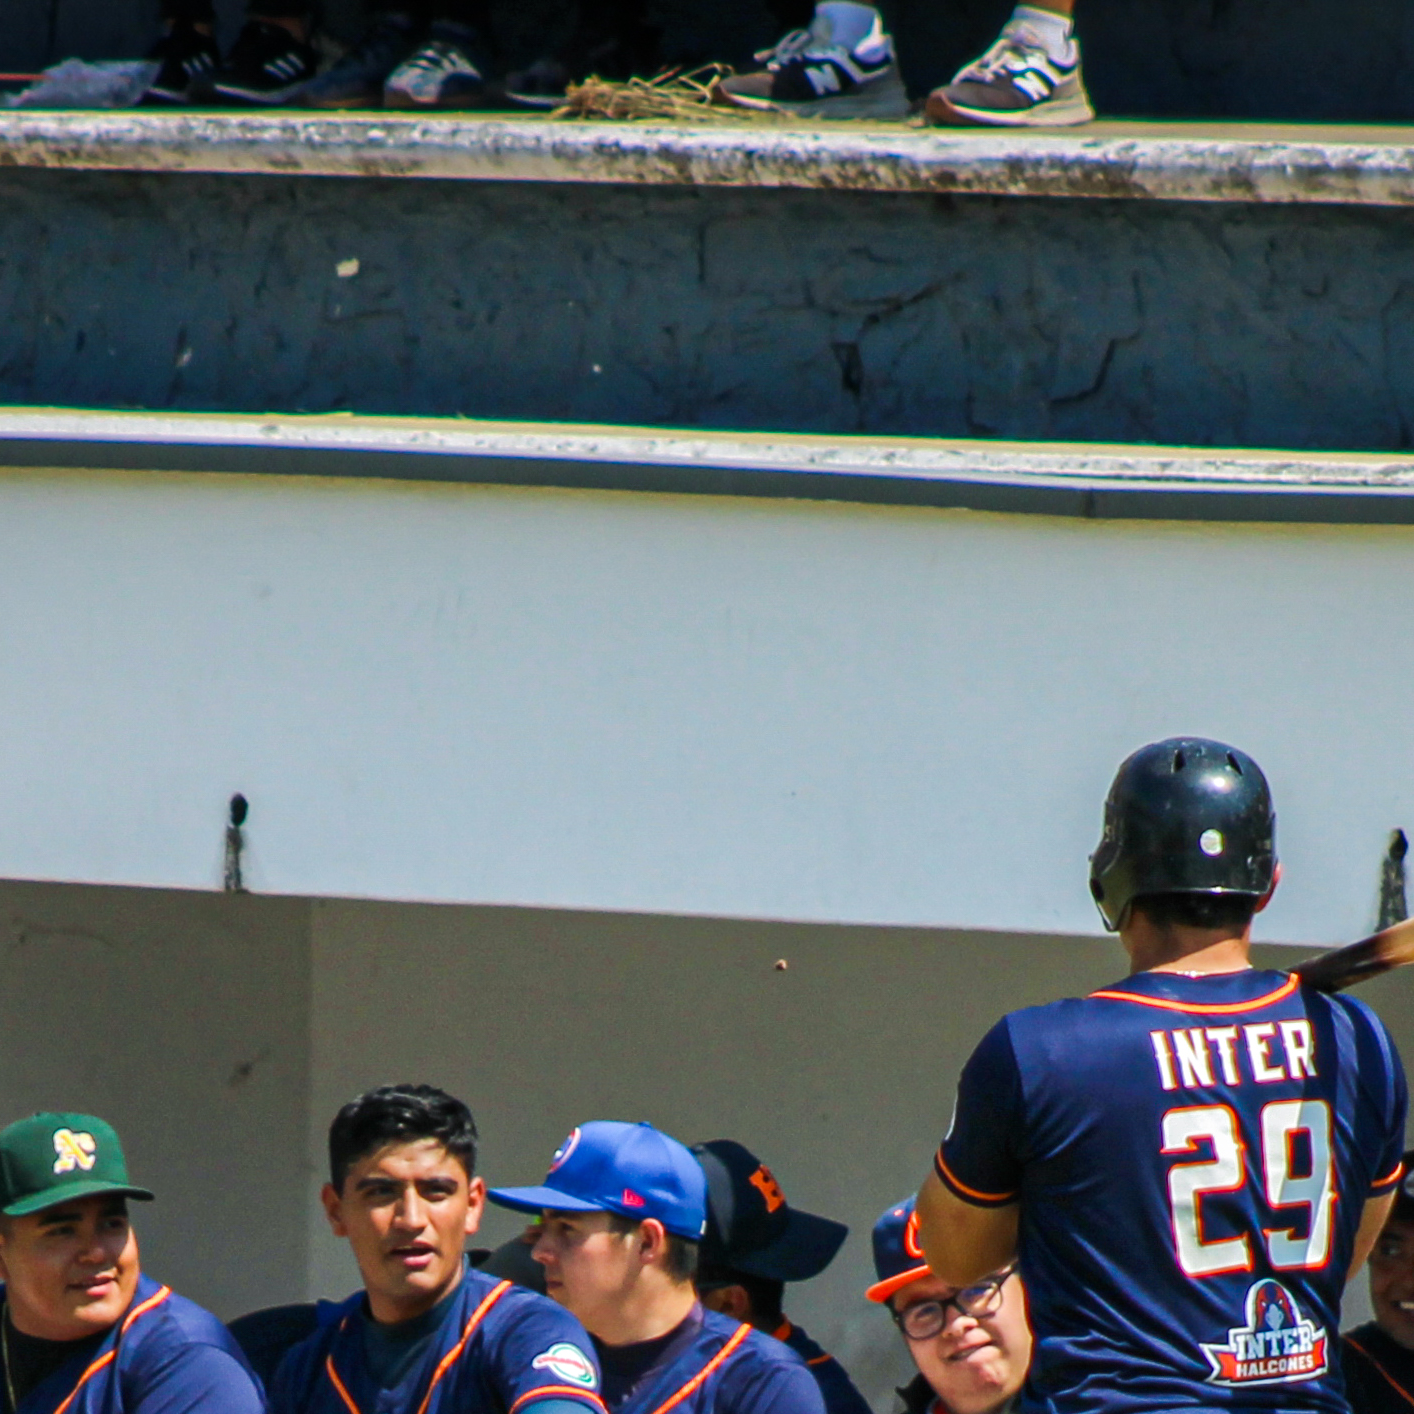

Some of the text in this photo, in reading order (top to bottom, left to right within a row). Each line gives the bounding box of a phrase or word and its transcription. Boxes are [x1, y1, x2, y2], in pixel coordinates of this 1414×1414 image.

[1150, 1018, 1319, 1091] INTER
[1159, 1098, 1339, 1279] 29
[1234, 1325, 1315, 1362] INTER
[1235, 1353, 1315, 1378] HALCONES
